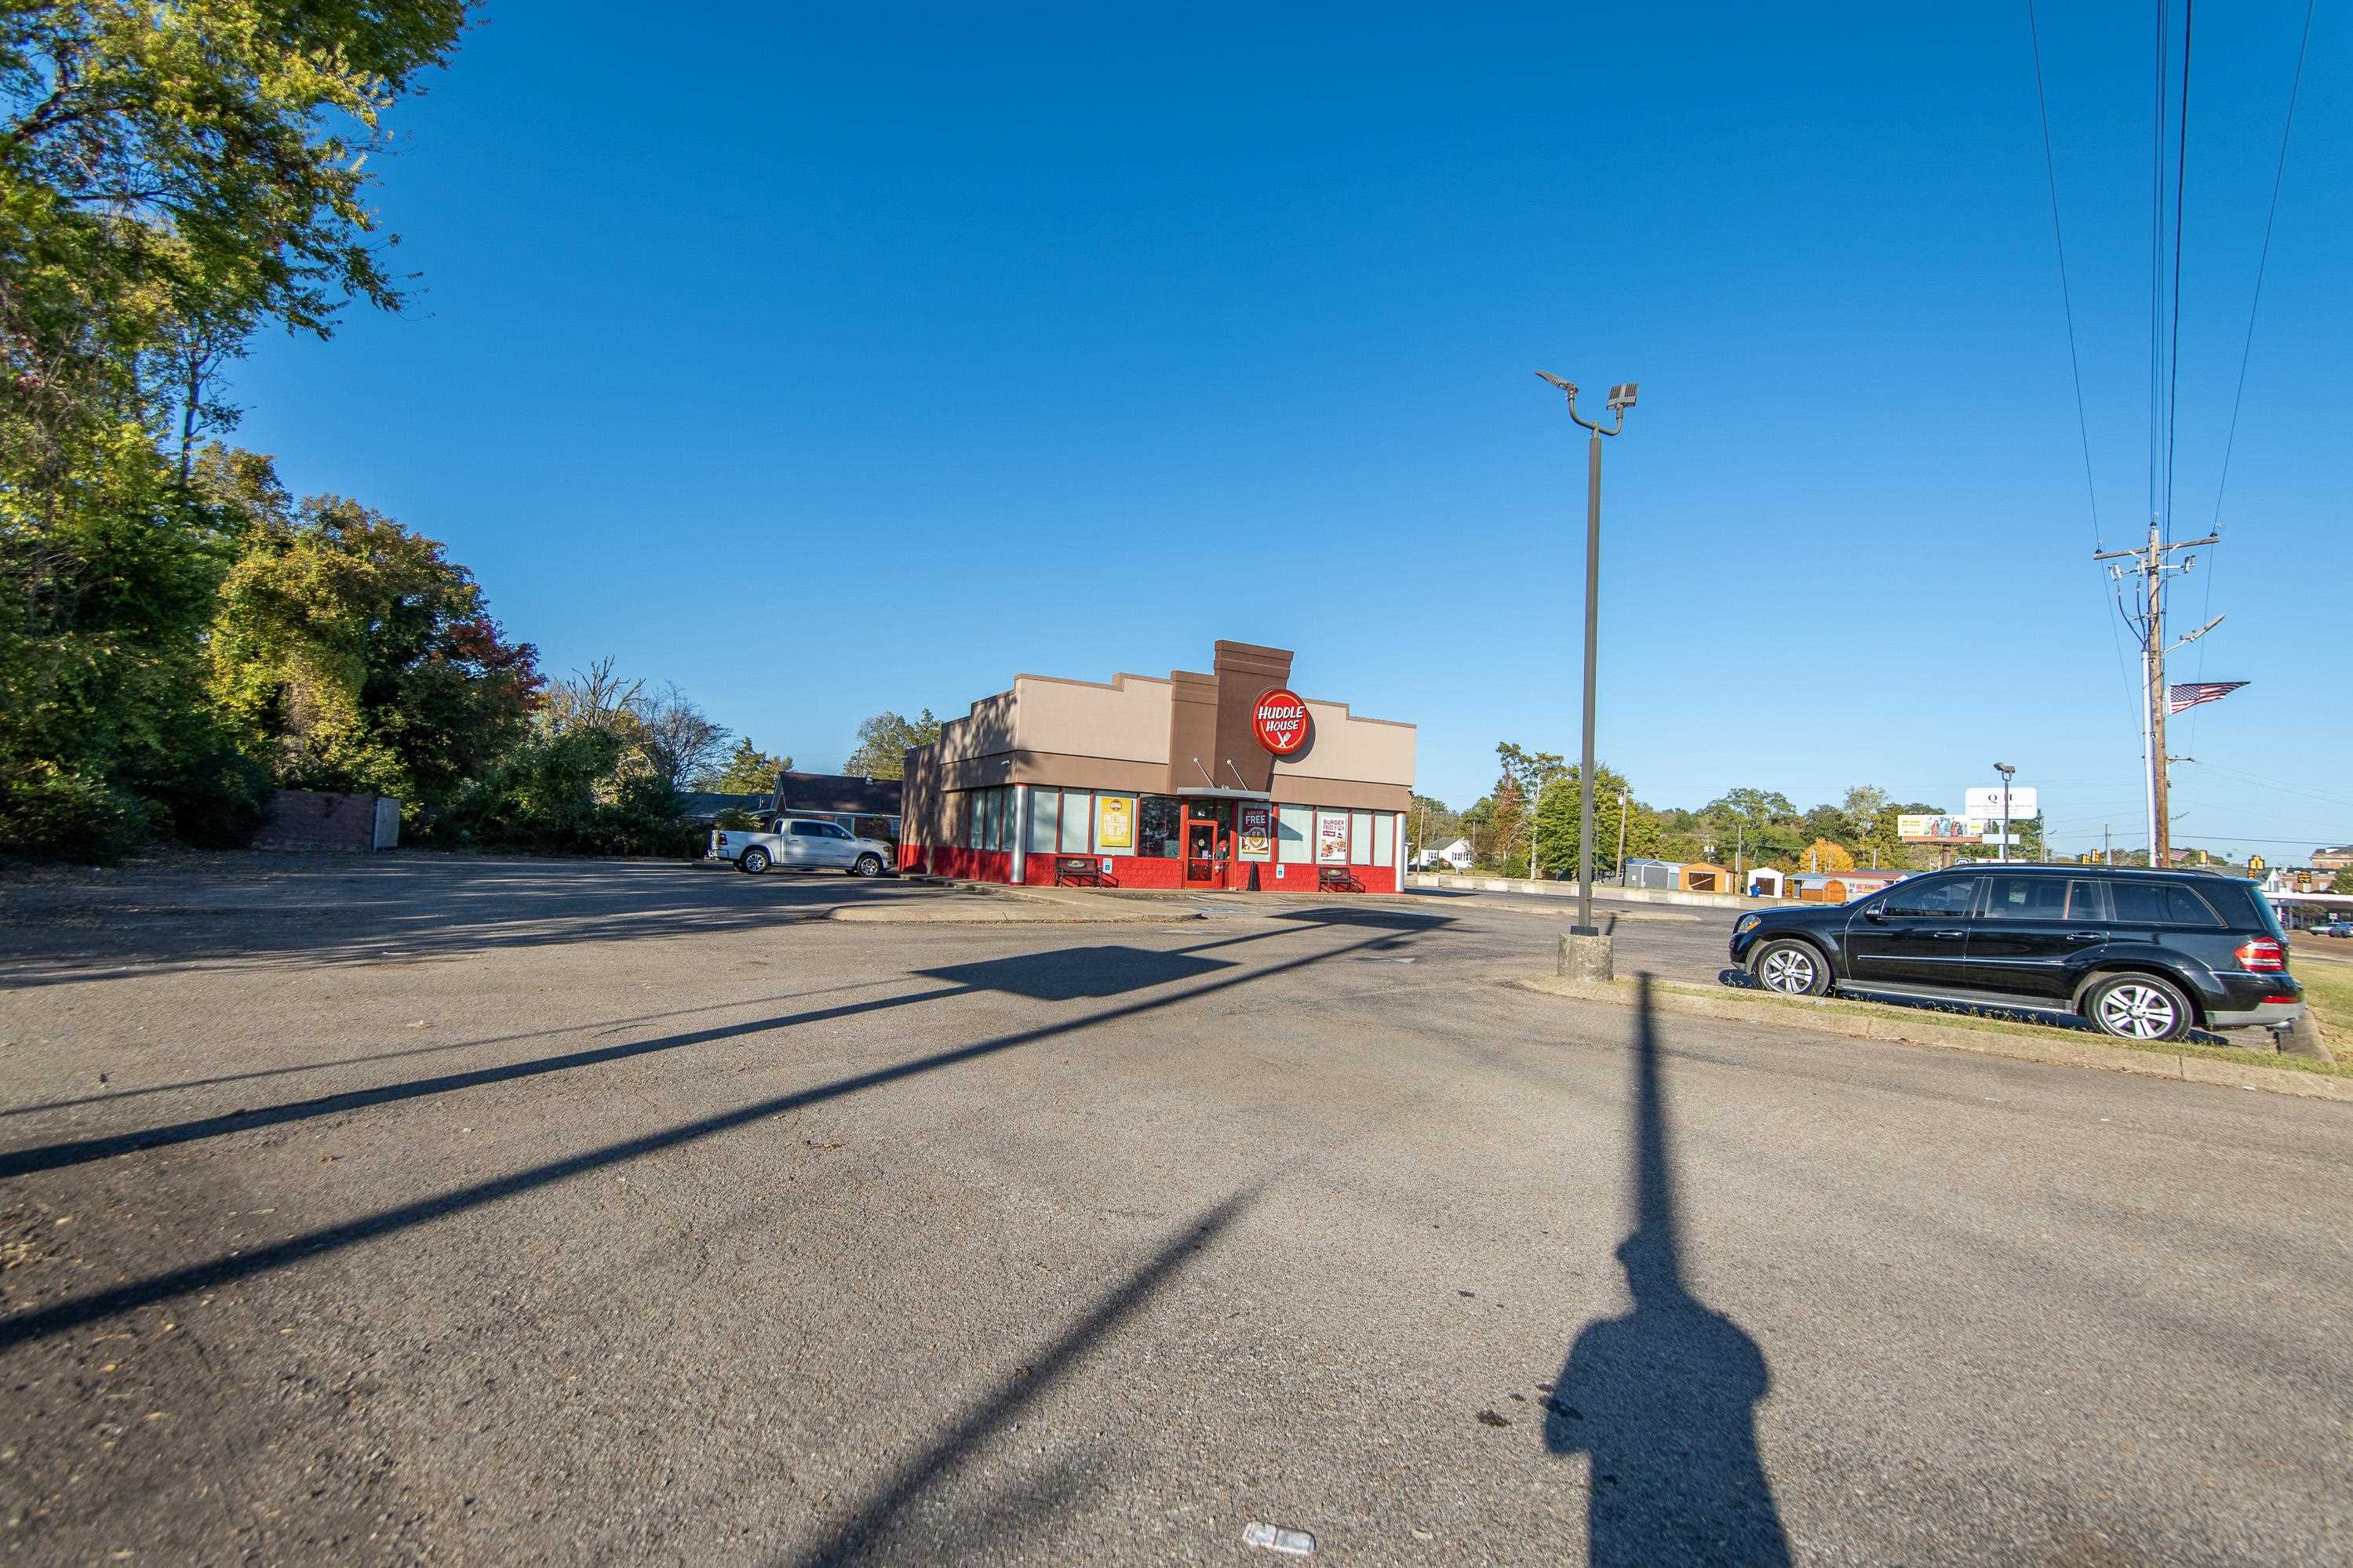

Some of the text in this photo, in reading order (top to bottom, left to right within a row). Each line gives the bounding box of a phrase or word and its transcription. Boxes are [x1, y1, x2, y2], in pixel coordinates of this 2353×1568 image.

[1258, 706, 1305, 720] HUDDLE
[1266, 720, 1299, 732] HOUSE
[1245, 815, 1266, 824] FREE
